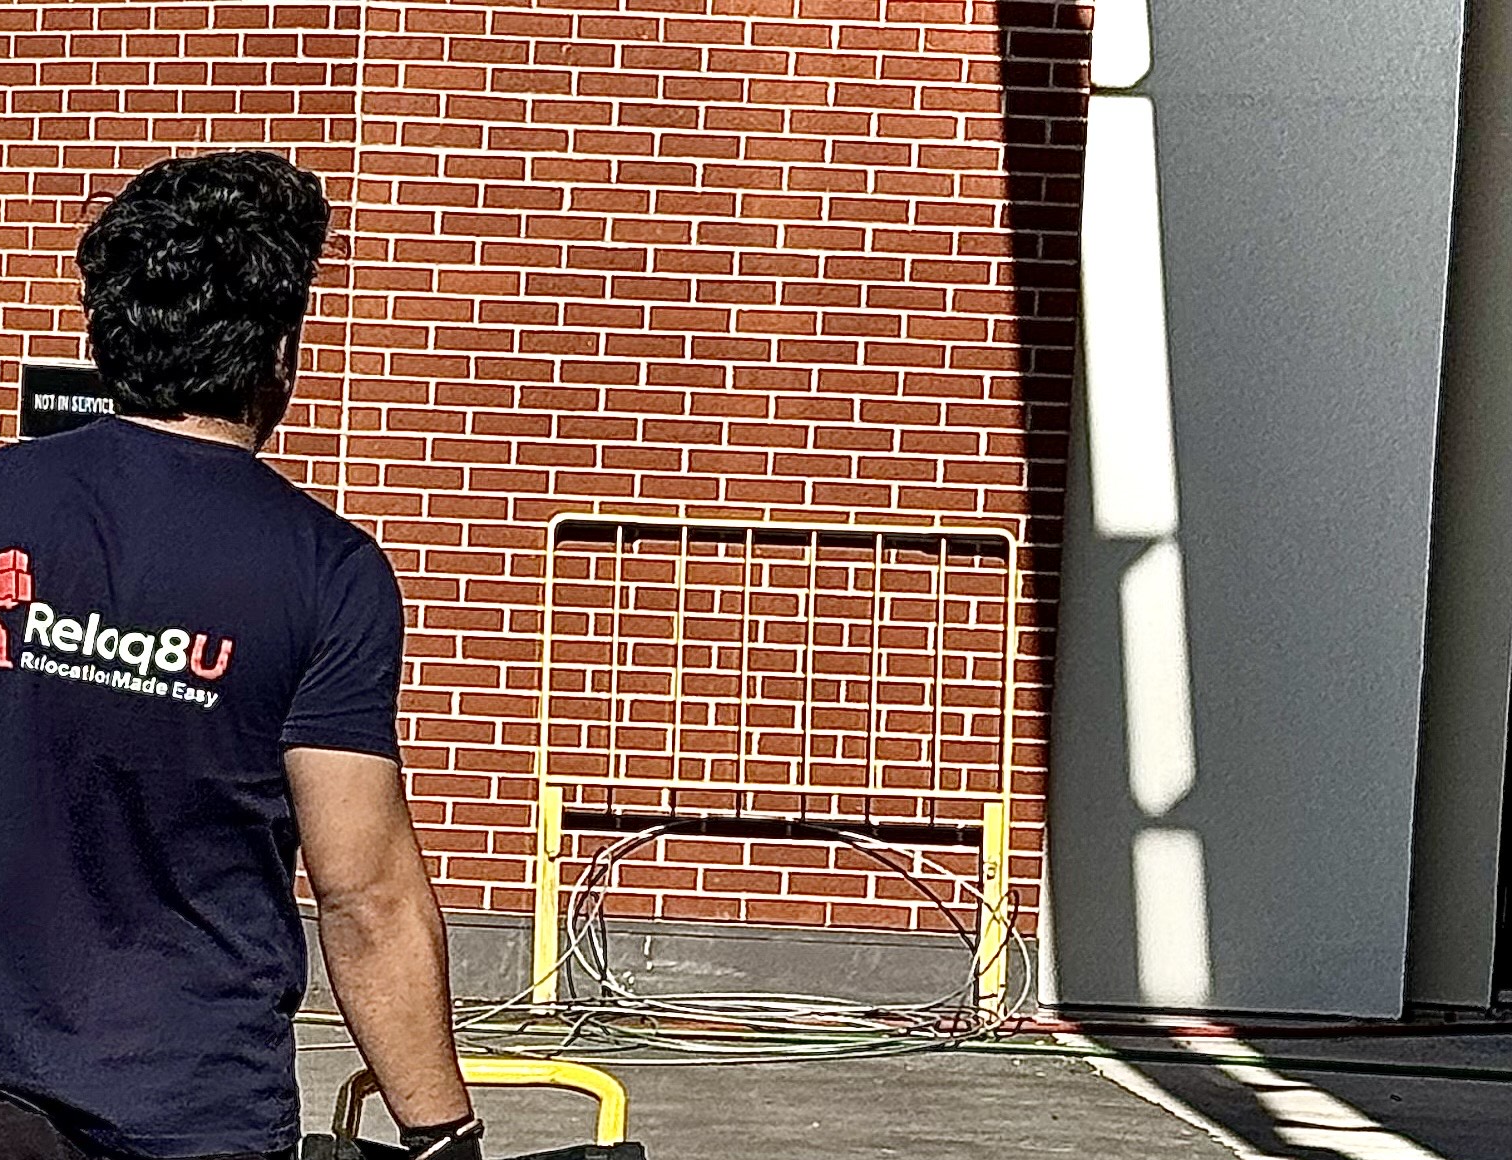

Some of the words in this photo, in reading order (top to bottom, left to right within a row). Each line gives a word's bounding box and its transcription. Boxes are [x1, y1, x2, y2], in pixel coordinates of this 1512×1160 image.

[34, 393, 55, 411] NOT
[57, 395, 69, 412] IN
[71, 396, 116, 415] SERVICE
[23, 602, 233, 681] Reloq8U
[112, 671, 168, 696] Made
[172, 681, 219, 708] Easy
